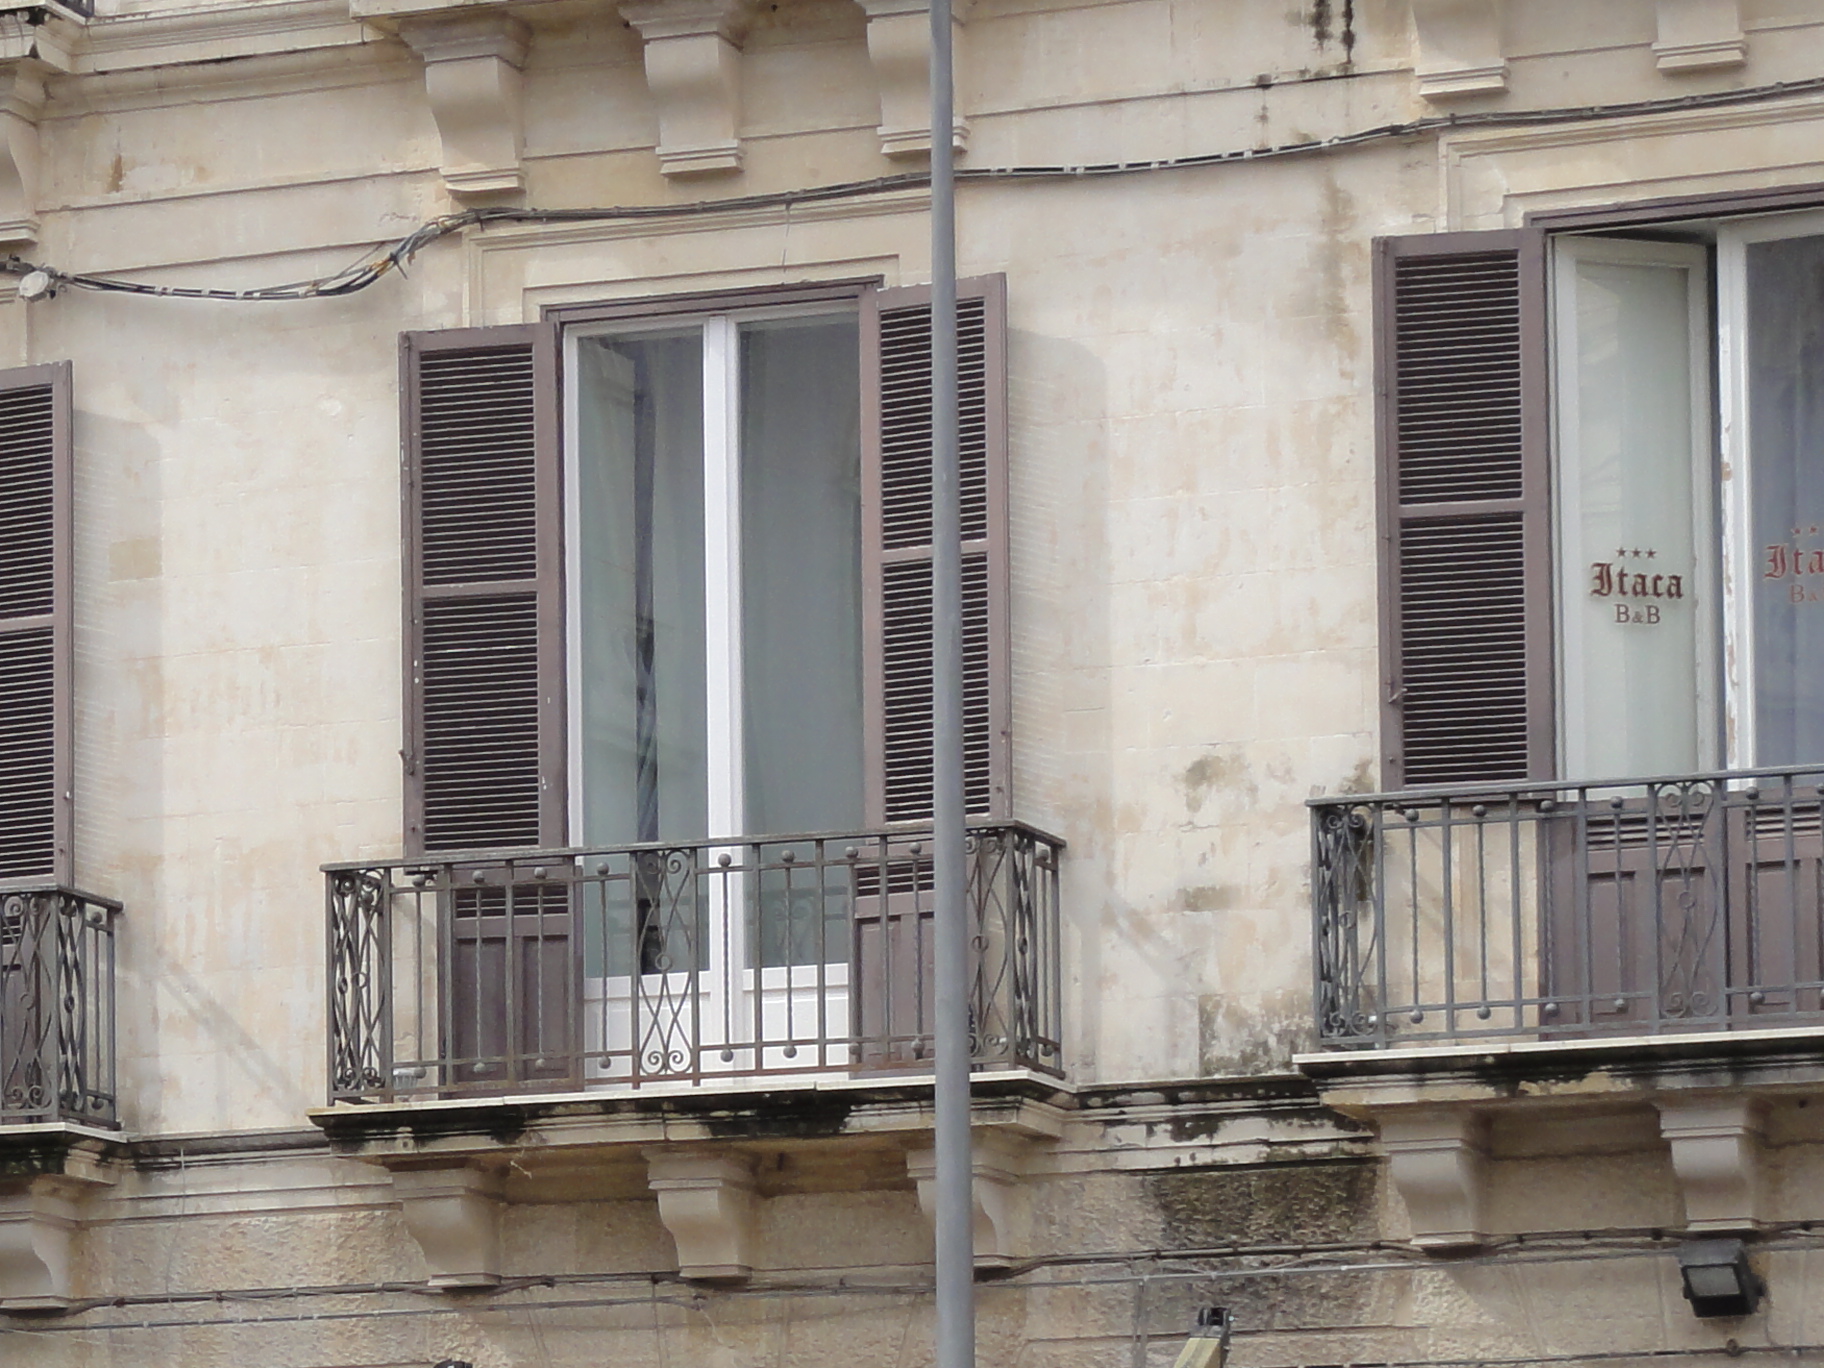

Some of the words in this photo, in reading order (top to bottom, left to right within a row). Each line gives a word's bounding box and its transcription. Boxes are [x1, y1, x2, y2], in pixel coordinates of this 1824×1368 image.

[1763, 543, 1824, 579] Ita
[1590, 562, 1684, 599] Itaca
[1790, 584, 1824, 603] B&
[1614, 604, 1661, 624] B&B
